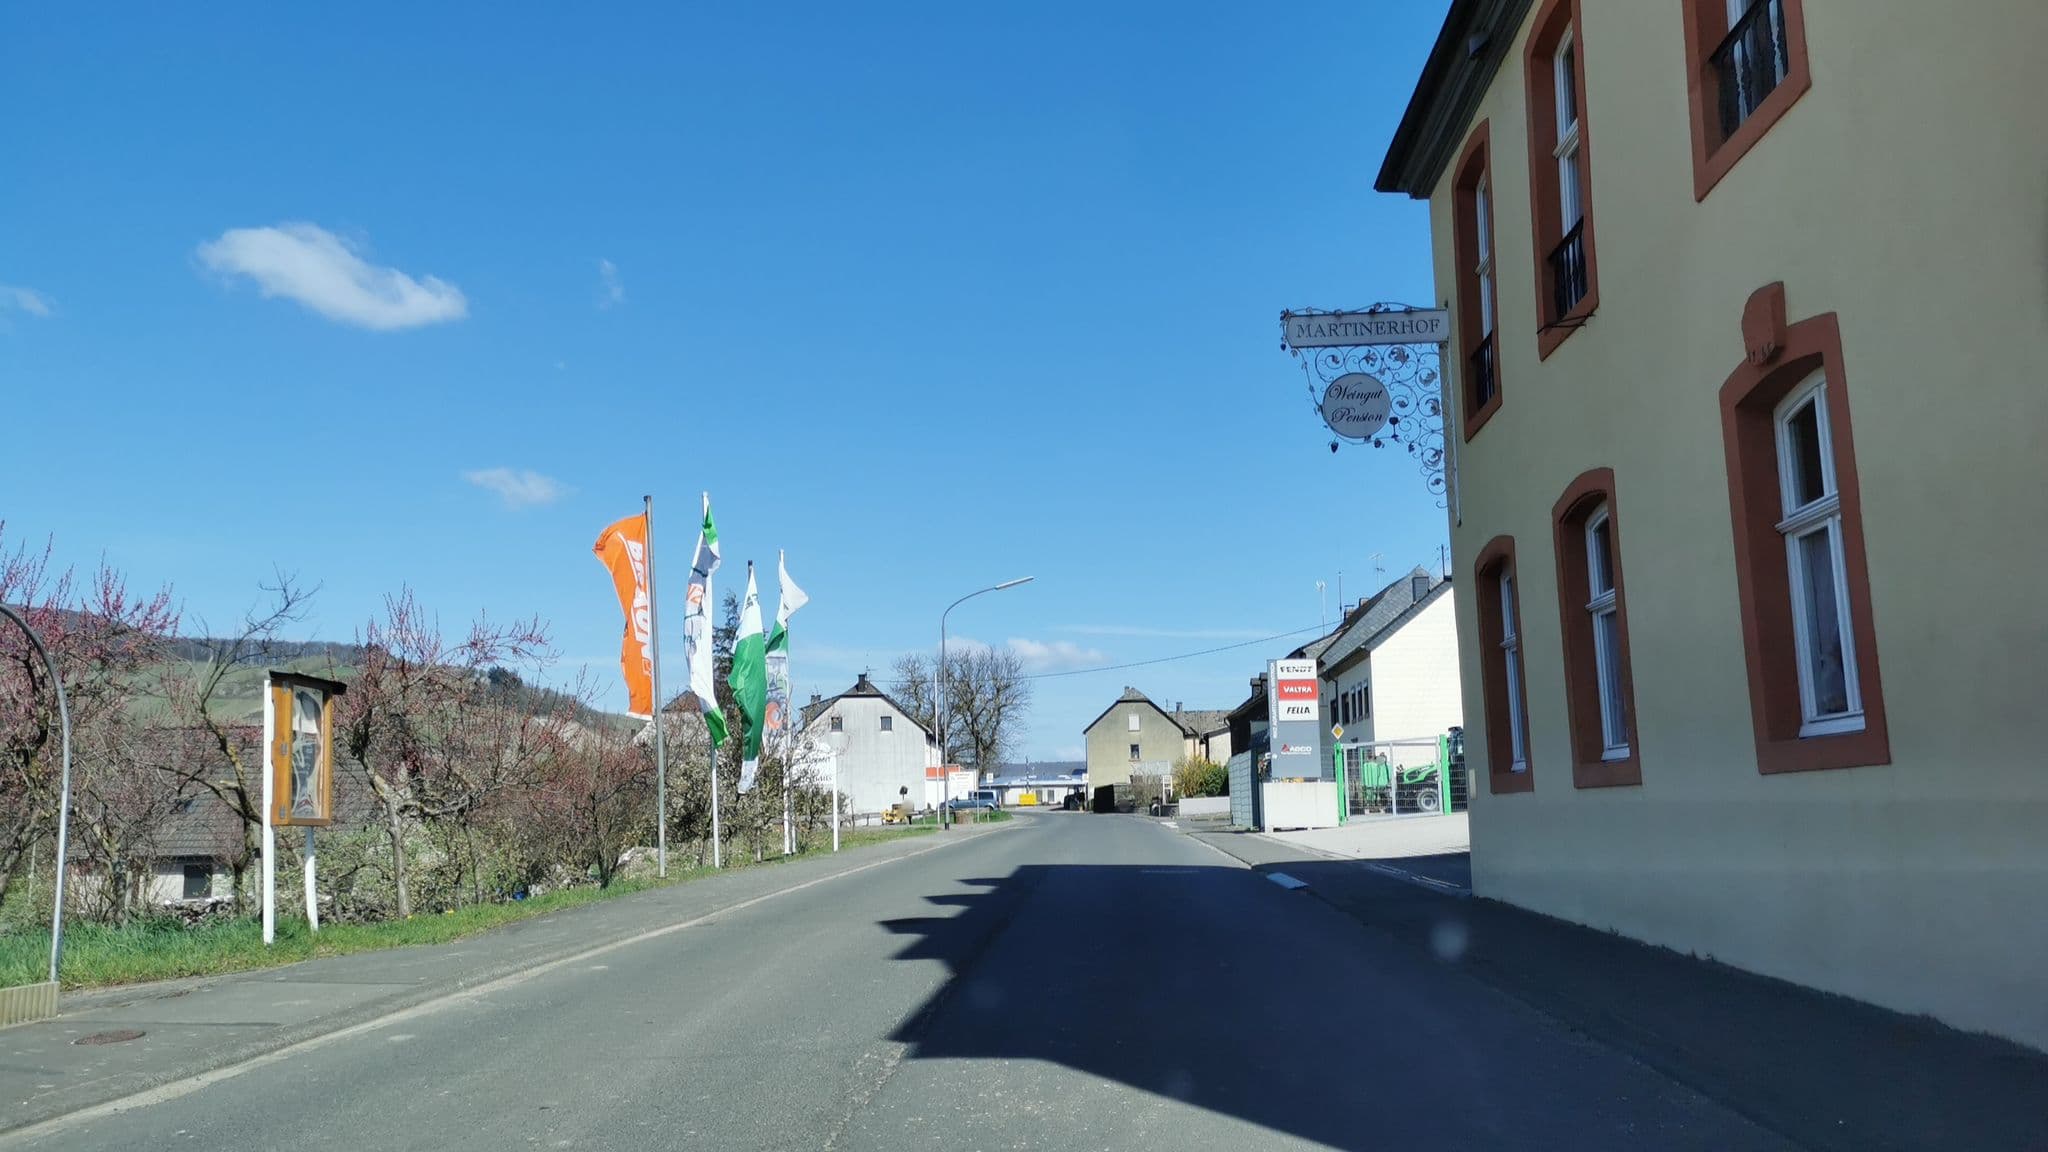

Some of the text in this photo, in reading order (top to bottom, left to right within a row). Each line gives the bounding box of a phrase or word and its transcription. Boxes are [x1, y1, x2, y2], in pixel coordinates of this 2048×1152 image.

[1297, 319, 1440, 338] MARTINERHOF
[1328, 383, 1383, 405] Weingut
[1331, 407, 1383, 423] Pension
[1286, 706, 1310, 714] FELLA
